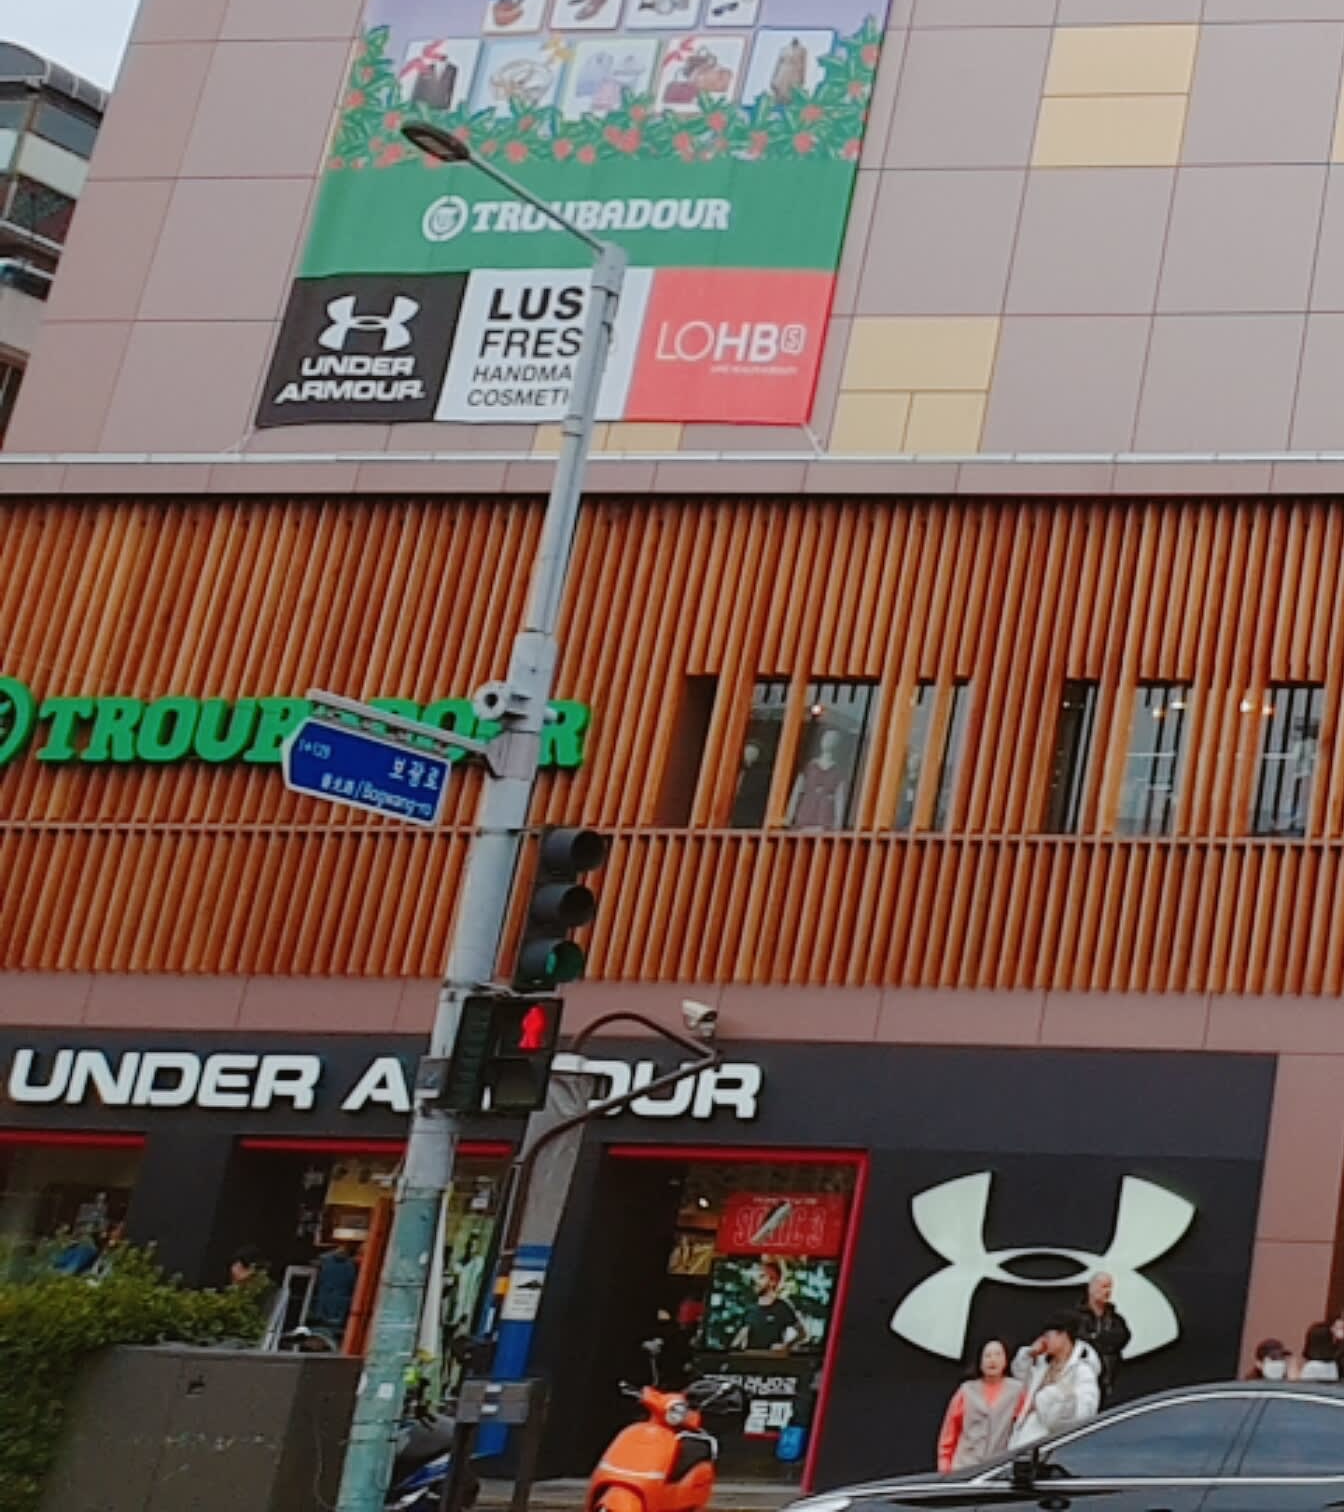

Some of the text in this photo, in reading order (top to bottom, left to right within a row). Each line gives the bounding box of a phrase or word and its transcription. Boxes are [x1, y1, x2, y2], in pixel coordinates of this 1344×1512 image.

[472, 197, 730, 234] TROUBADOUR
[487, 287, 584, 321] LUS
[478, 326, 584, 359] FRES
[301, 355, 414, 377] UNDER
[472, 363, 573, 383] HANDMA
[274, 378, 426, 404] ARMOUR
[467, 388, 570, 407] COSMETI
[388, 756, 441, 790] 보광로
[8, 1048, 762, 1120] UNDER AOUR
